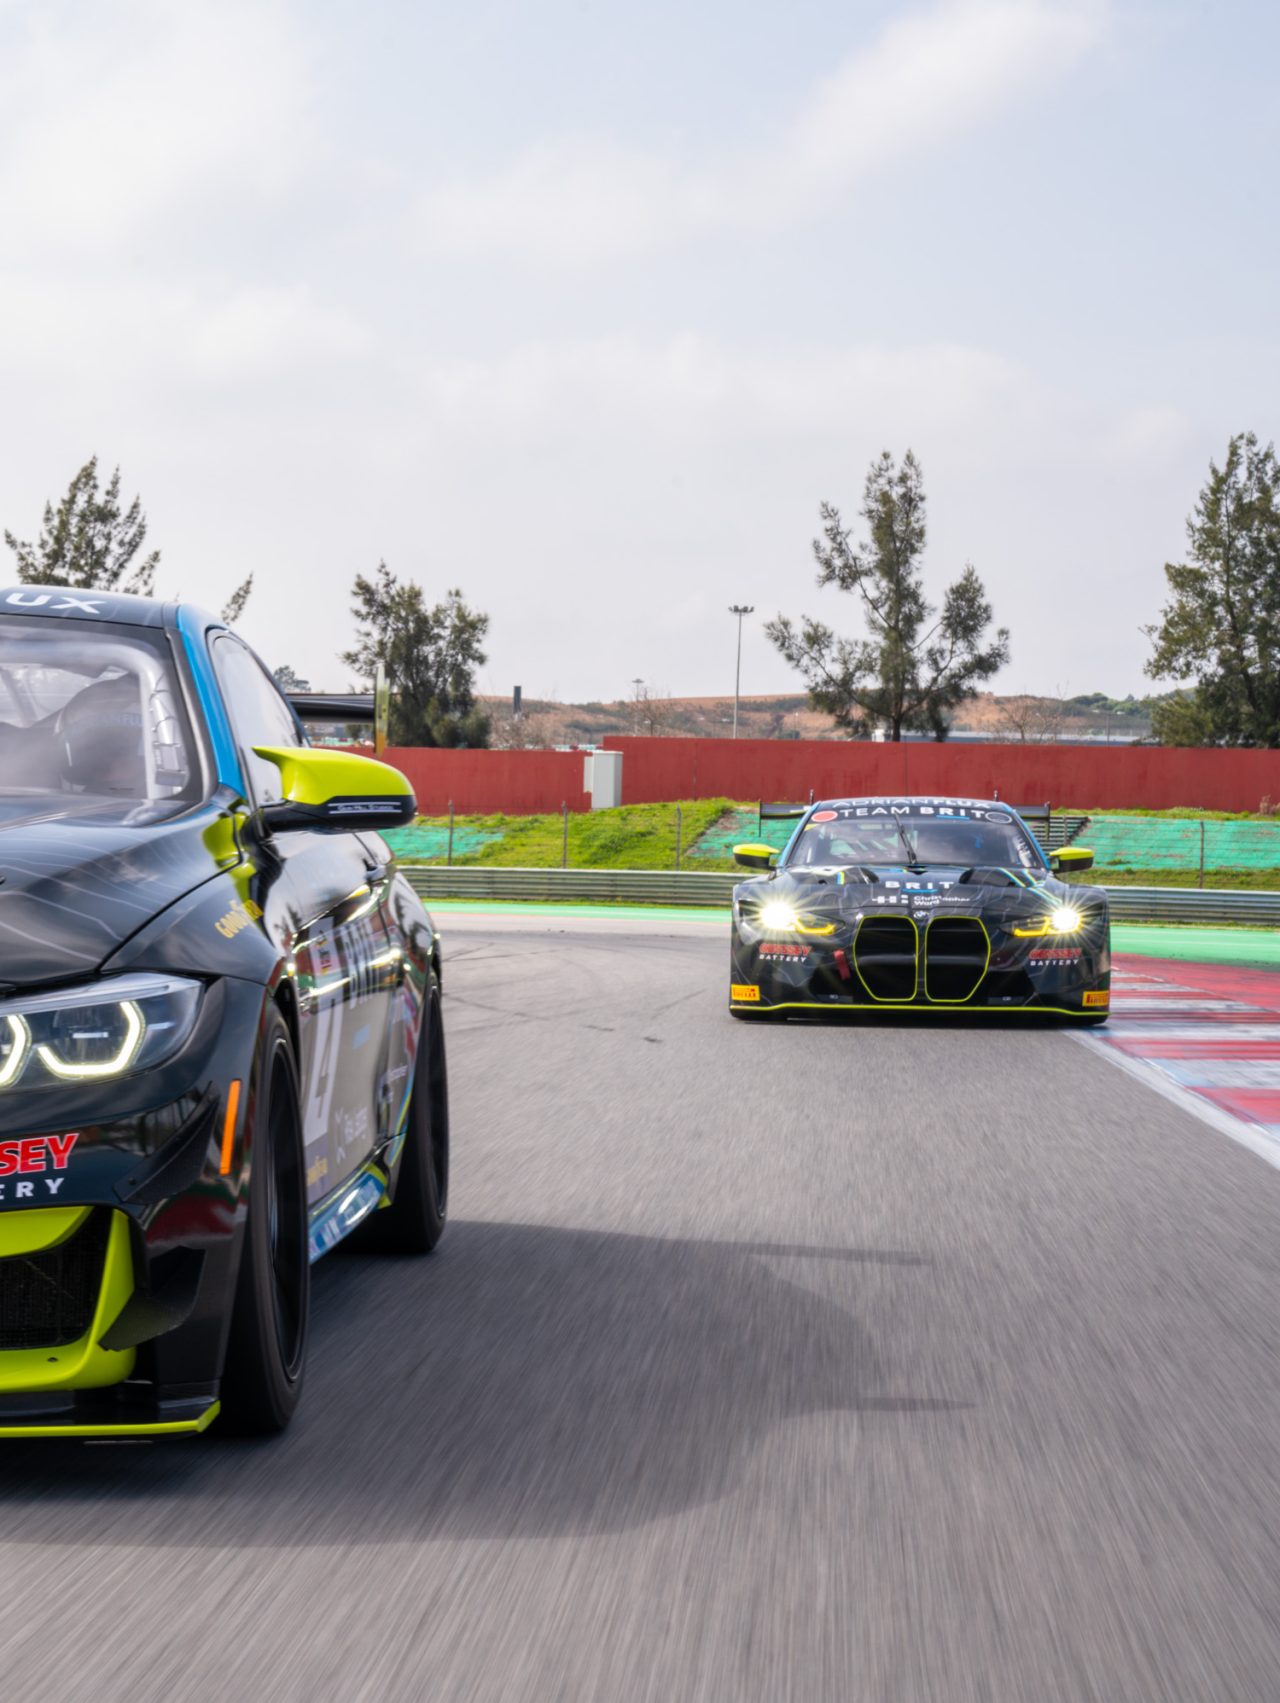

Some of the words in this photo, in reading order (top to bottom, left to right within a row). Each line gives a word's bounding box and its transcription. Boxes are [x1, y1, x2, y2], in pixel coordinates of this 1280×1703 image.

[839, 806, 910, 818] TEAM
[919, 806, 986, 818] BRIT
[885, 880, 955, 890] BRIT
[759, 954, 807, 963] BATTERY
